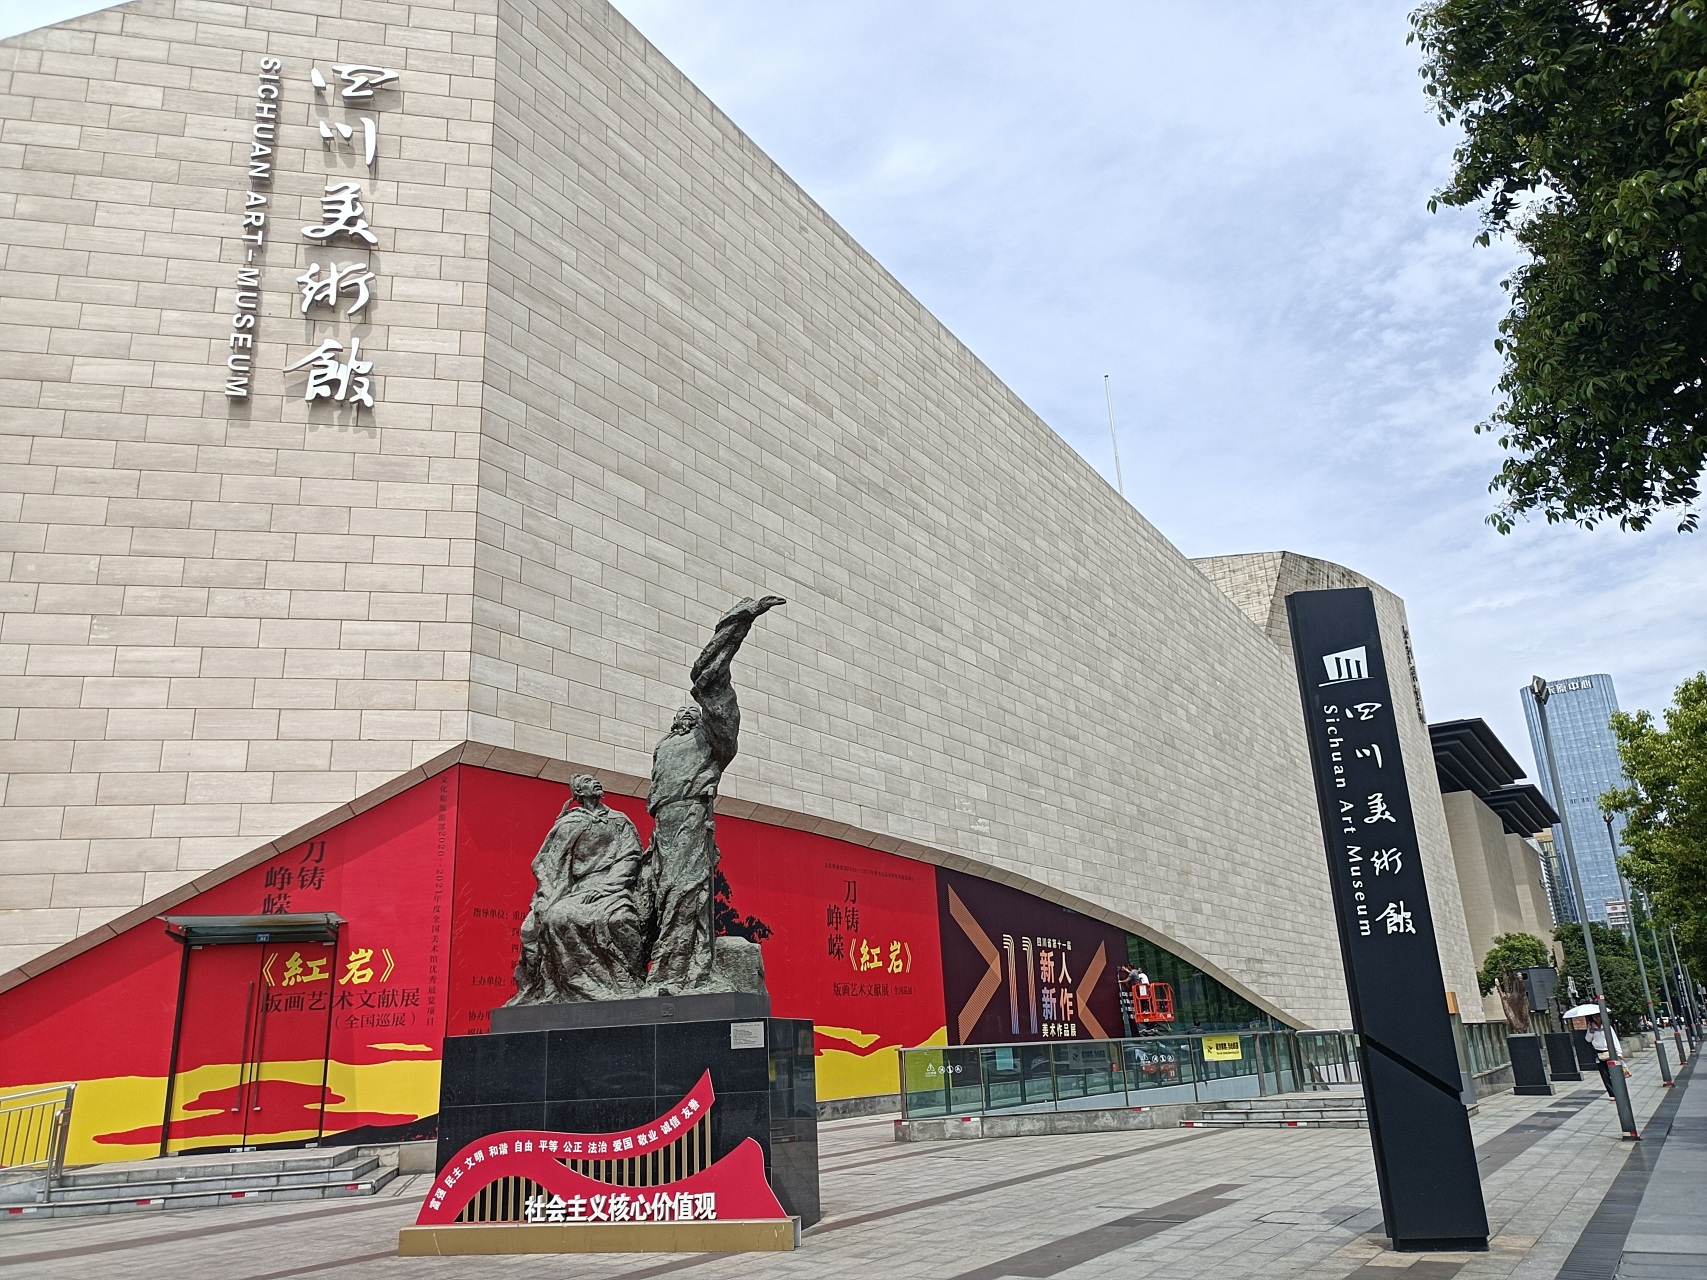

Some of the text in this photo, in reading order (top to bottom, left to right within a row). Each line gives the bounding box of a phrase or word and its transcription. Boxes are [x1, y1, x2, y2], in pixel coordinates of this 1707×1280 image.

[248, 57, 281, 180] SICHUAN
[1323, 704, 1372, 937] Sichuan Art Museum
[297, 840, 326, 891] 刀铸
[262, 866, 293, 914] 峥嵘
[843, 880, 859, 933] 刀铸
[827, 904, 844, 961] 峥嵘
[1036, 937, 1072, 951] 四川省第十一届
[1039, 949, 1072, 984] 新人
[260, 987, 420, 1013] 版画艺术文献展
[833, 982, 889, 997] 版画艺术文献展
[1041, 986, 1074, 1021] 新作
[1041, 1022, 1077, 1038] 美术作品展
[429, 1098, 700, 1211] 富强 民主 文明 和谐 自由 平等 公正 法治 爱国 敬业 诚信 友善
[524, 1191, 717, 1223] 社会主义核心价值观
